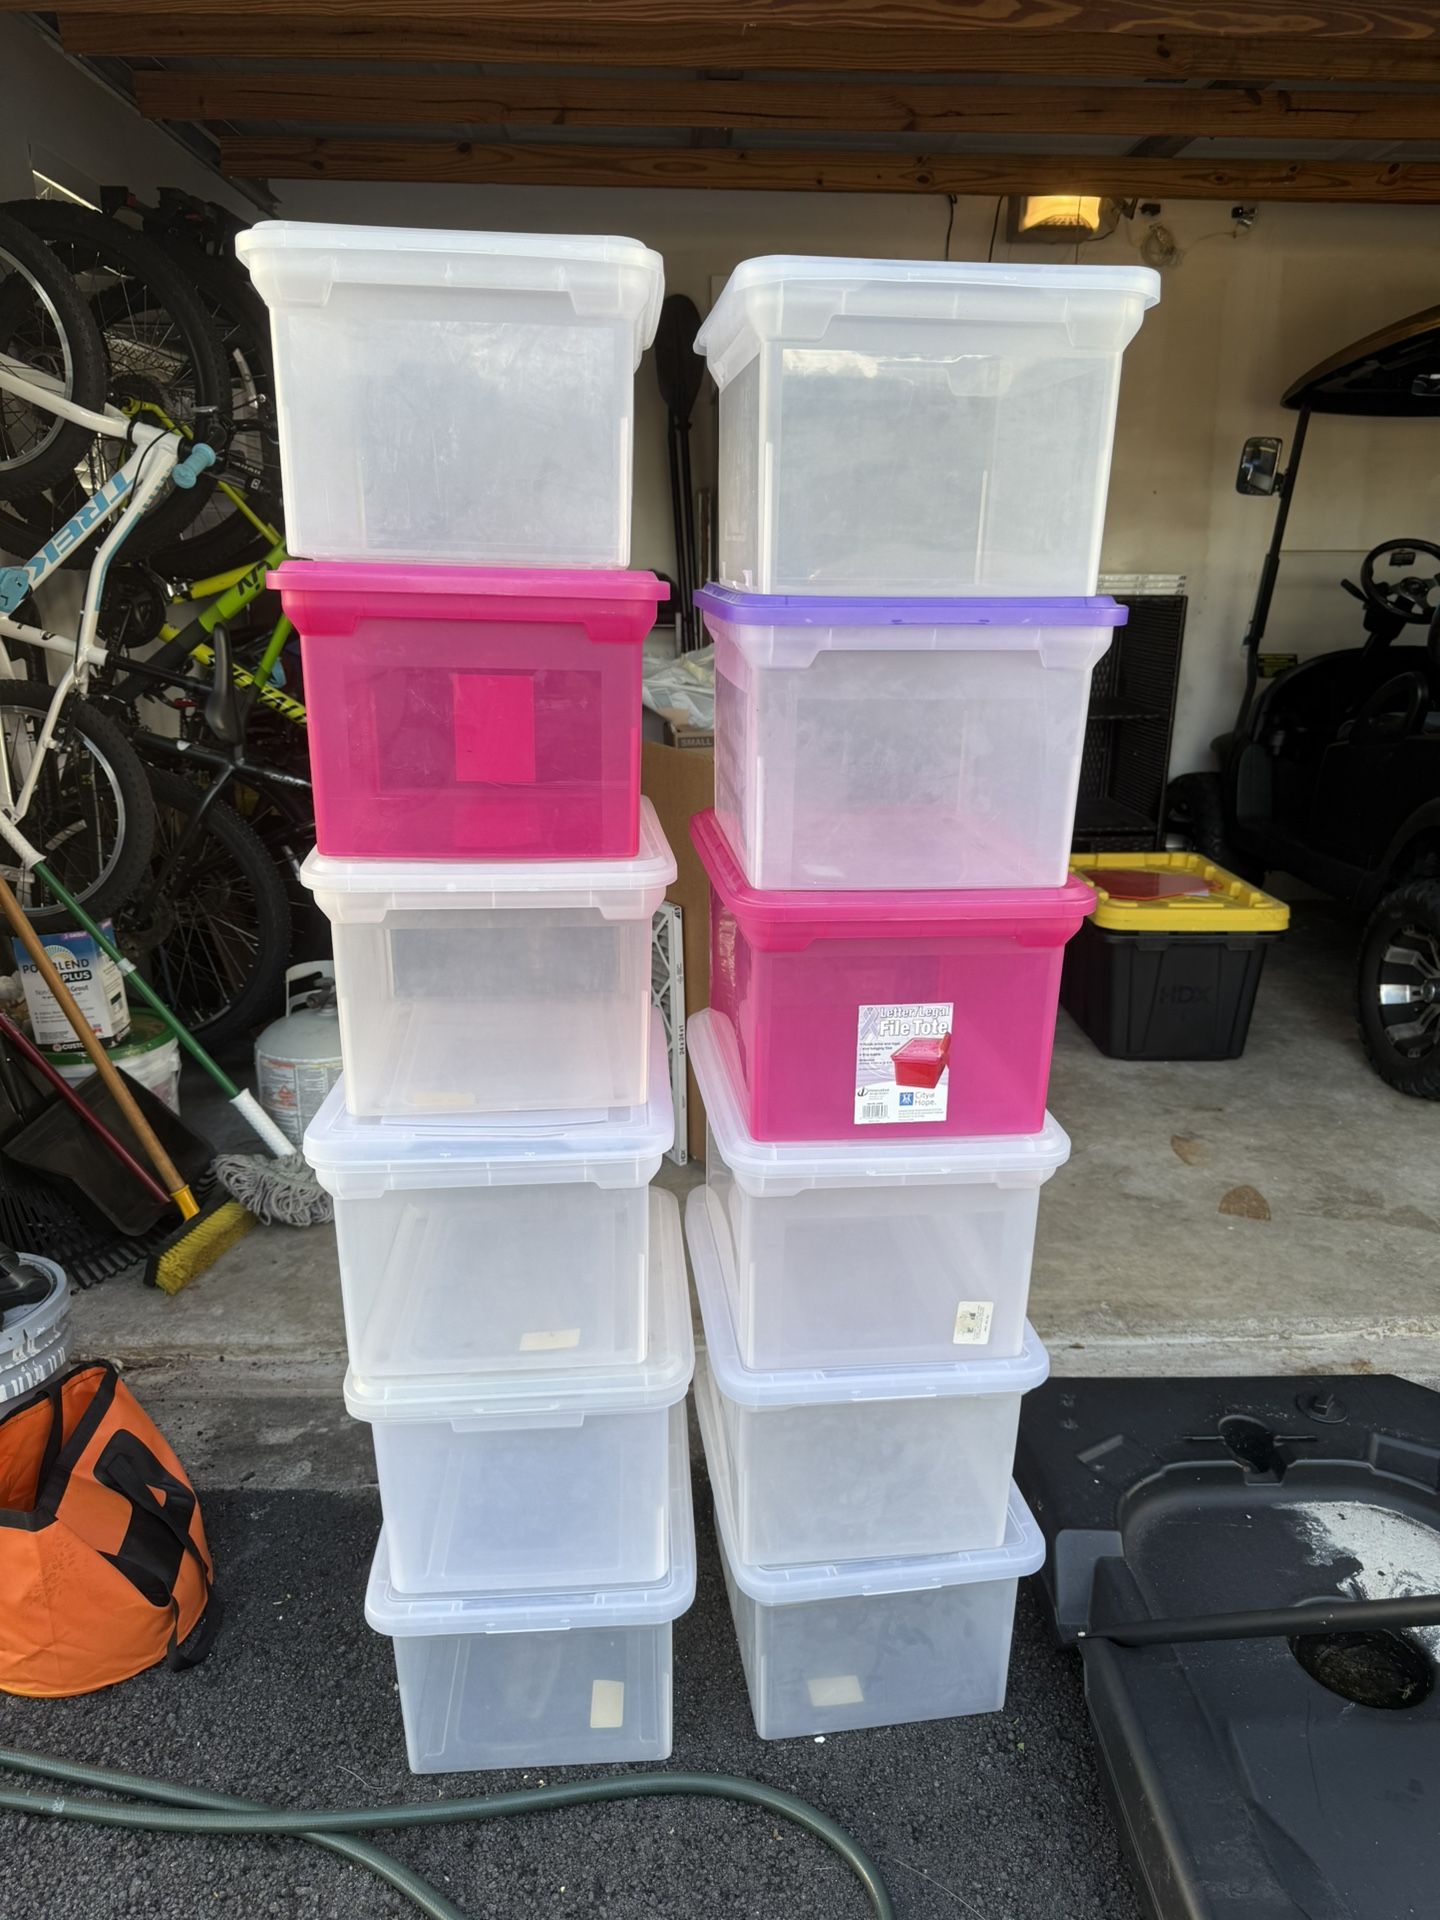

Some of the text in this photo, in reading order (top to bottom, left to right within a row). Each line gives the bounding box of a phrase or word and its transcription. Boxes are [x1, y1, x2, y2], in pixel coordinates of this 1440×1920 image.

[24, 471, 136, 581] TREK
[62, 971, 90, 982] PLUS
[880, 1006, 950, 1018] Letter/Legal
[880, 1018, 948, 1036] File Tote
